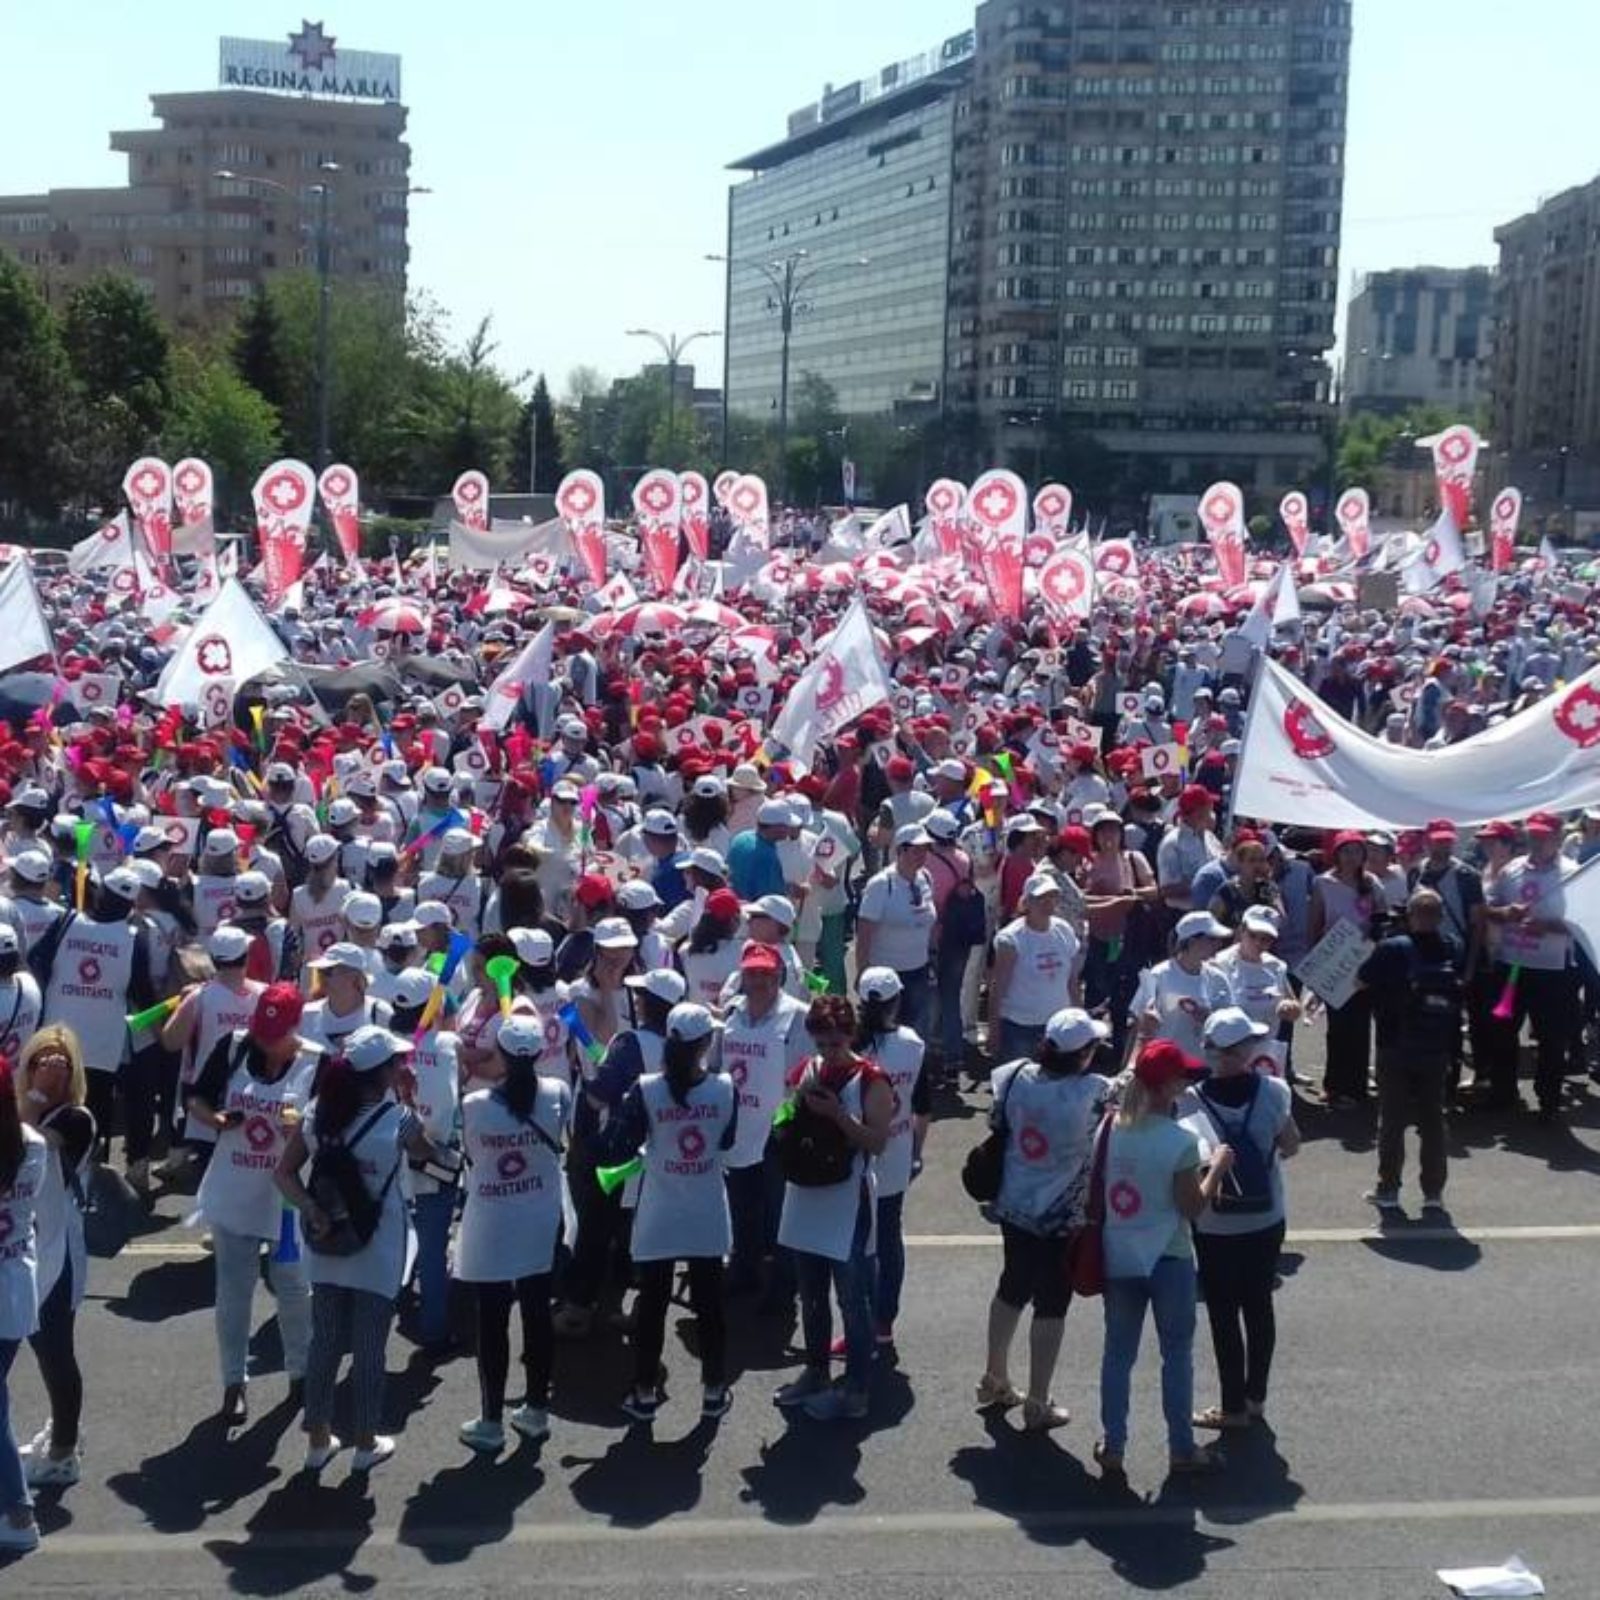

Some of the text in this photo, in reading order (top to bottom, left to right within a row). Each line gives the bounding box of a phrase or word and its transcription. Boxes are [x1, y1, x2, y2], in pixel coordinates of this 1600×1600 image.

[226, 65, 395, 98] REGINA MARIA
[477, 1175, 543, 1198] CONSTANTA
